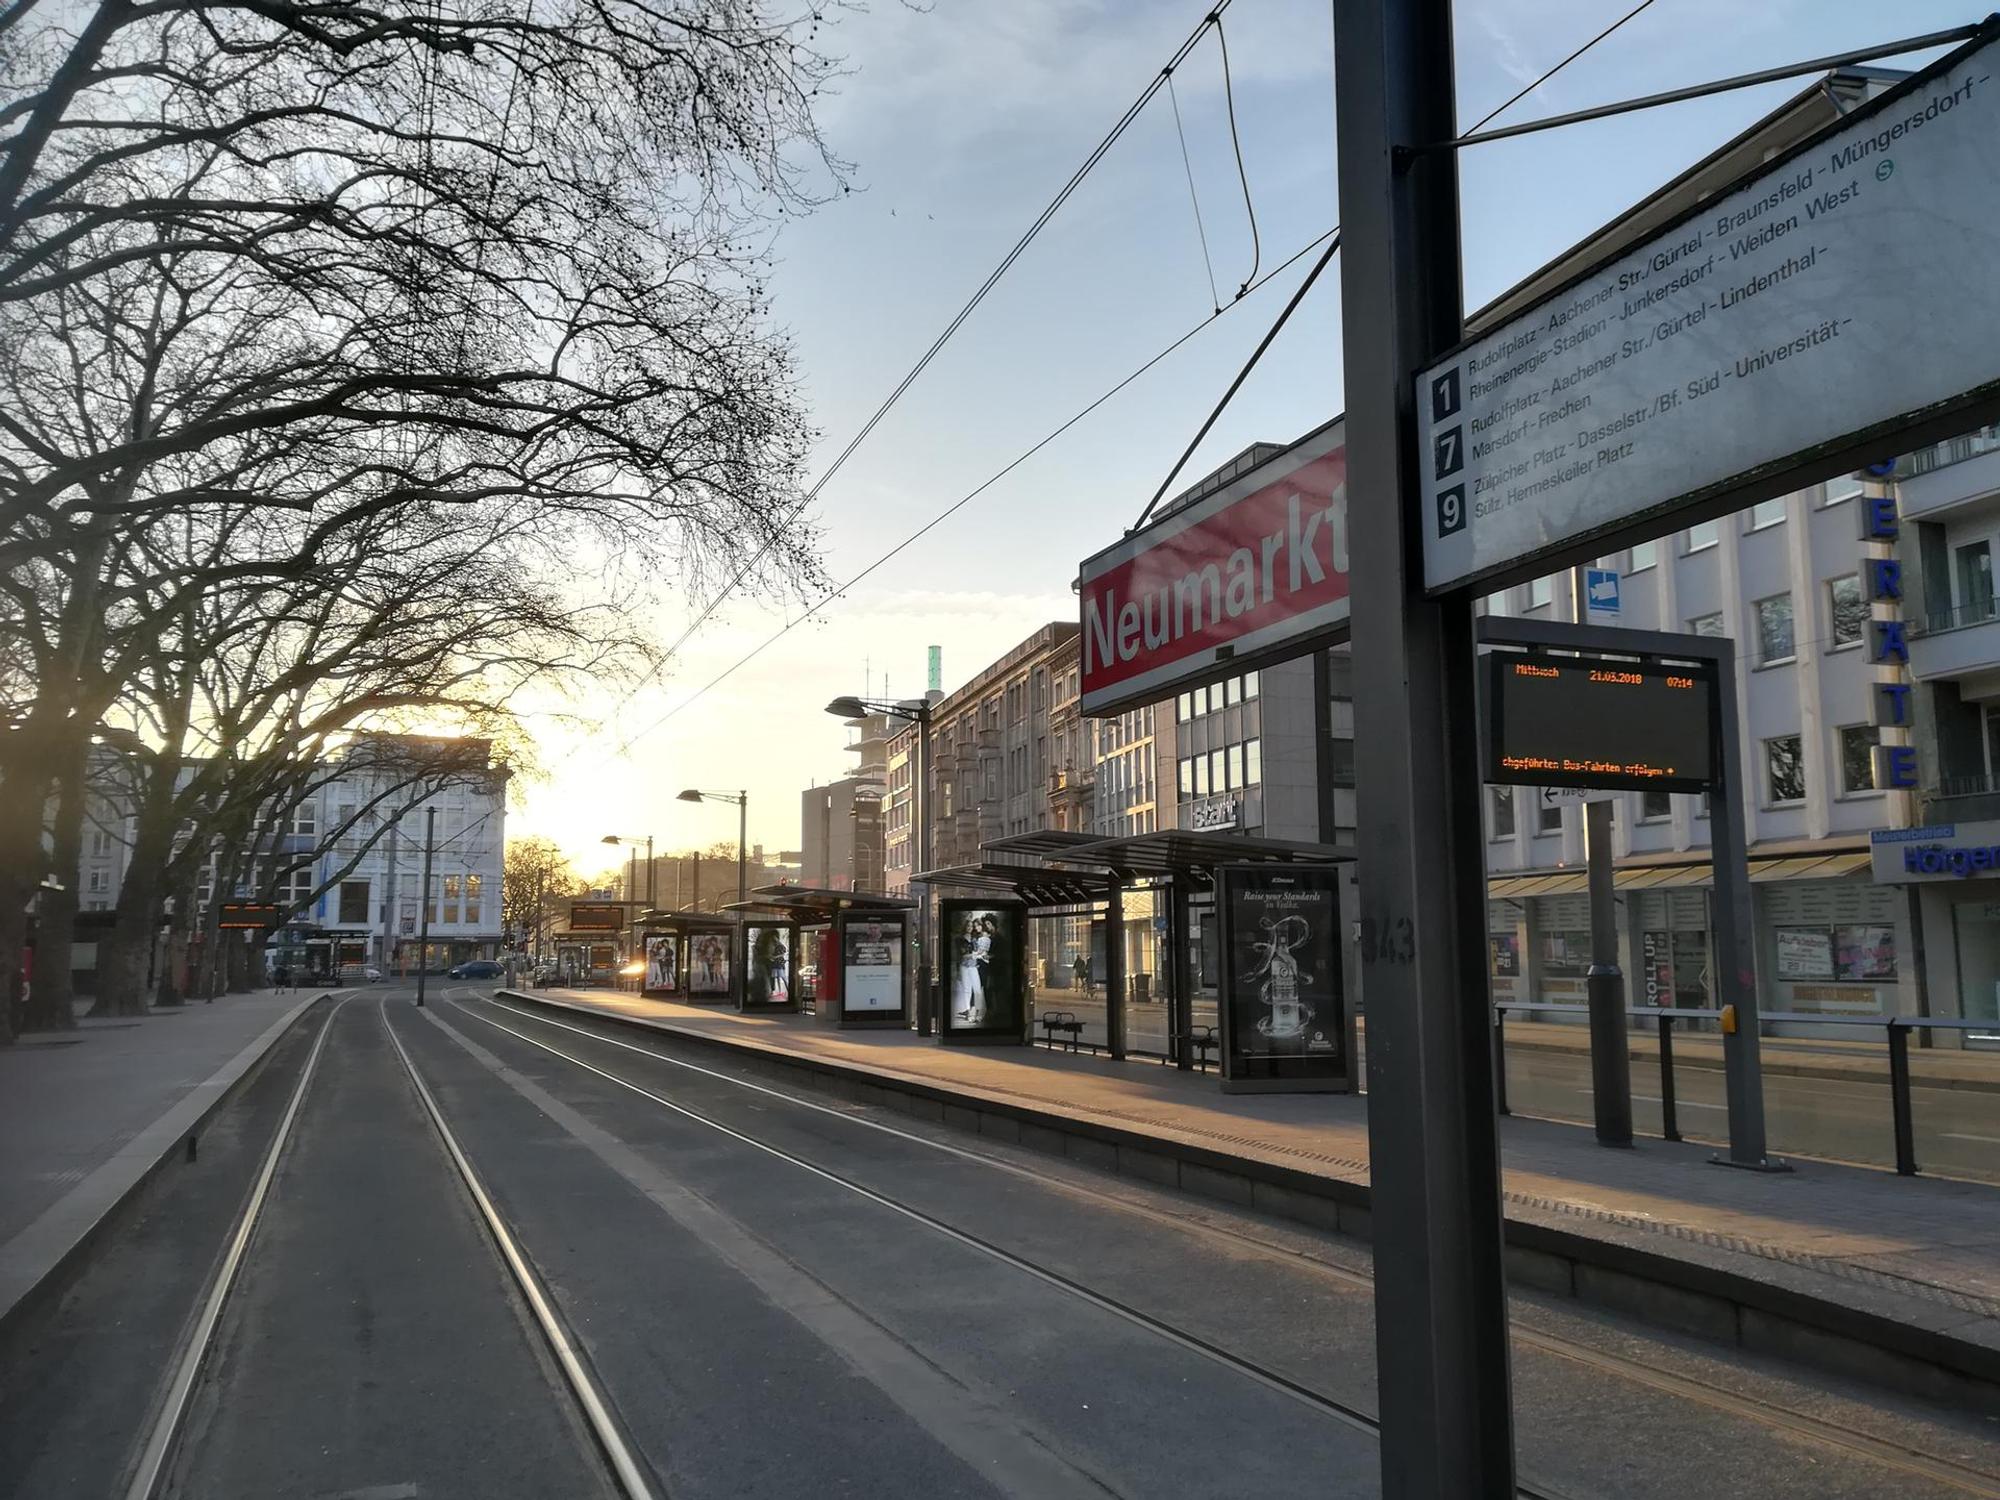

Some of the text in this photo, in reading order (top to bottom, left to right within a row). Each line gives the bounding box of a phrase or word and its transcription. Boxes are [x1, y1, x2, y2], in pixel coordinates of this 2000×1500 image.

[1469, 330, 1537, 376] Rudolfplatz
[1549, 284, 1614, 332] Aachener
[1618, 231, 1703, 291] Str./Gürtel
[1717, 169, 1813, 237] Braunsfeld
[1832, 76, 1974, 173] Müngersdorf
[1470, 318, 1607, 401] Rheinenergie-Stadion
[1619, 256, 1714, 321] Junkersdorf
[1729, 215, 1798, 261] Weiden
[1805, 180, 1860, 220] West
[1471, 391, 1540, 435] Rudolfplatz
[1552, 352, 1618, 396] Aachener
[1622, 302, 1706, 359] Str./Gürtel
[1720, 247, 1816, 310] Lindenthal
[1438, 377, 1451, 412] 1
[1474, 460, 1530, 495] Zülpicher
[1533, 444, 1567, 468] Platz
[1577, 389, 1683, 449] Dasselstr./Bf.
[1687, 371, 1720, 400] Süd
[1735, 318, 1840, 378] Universität
[1472, 422, 1529, 461] Marsdorf
[1539, 394, 1592, 430] Frechen
[1440, 434, 1457, 471] 7
[1507, 458, 1593, 505] Hermeskeiler
[1596, 442, 1634, 468] Platz
[1442, 494, 1460, 529] 9
[1084, 480, 1348, 675] Neumarkt
[1515, 664, 1693, 688] Mittwoch 21.03.2018 07:14
[1563, 759, 1621, 774] Bus-Fahrten
[1625, 764, 1663, 777] erfolgen
[1243, 890, 1320, 903] Raise your Standards
[1645, 934, 1656, 957] UP
[1645, 960, 1659, 1006] ROLL
